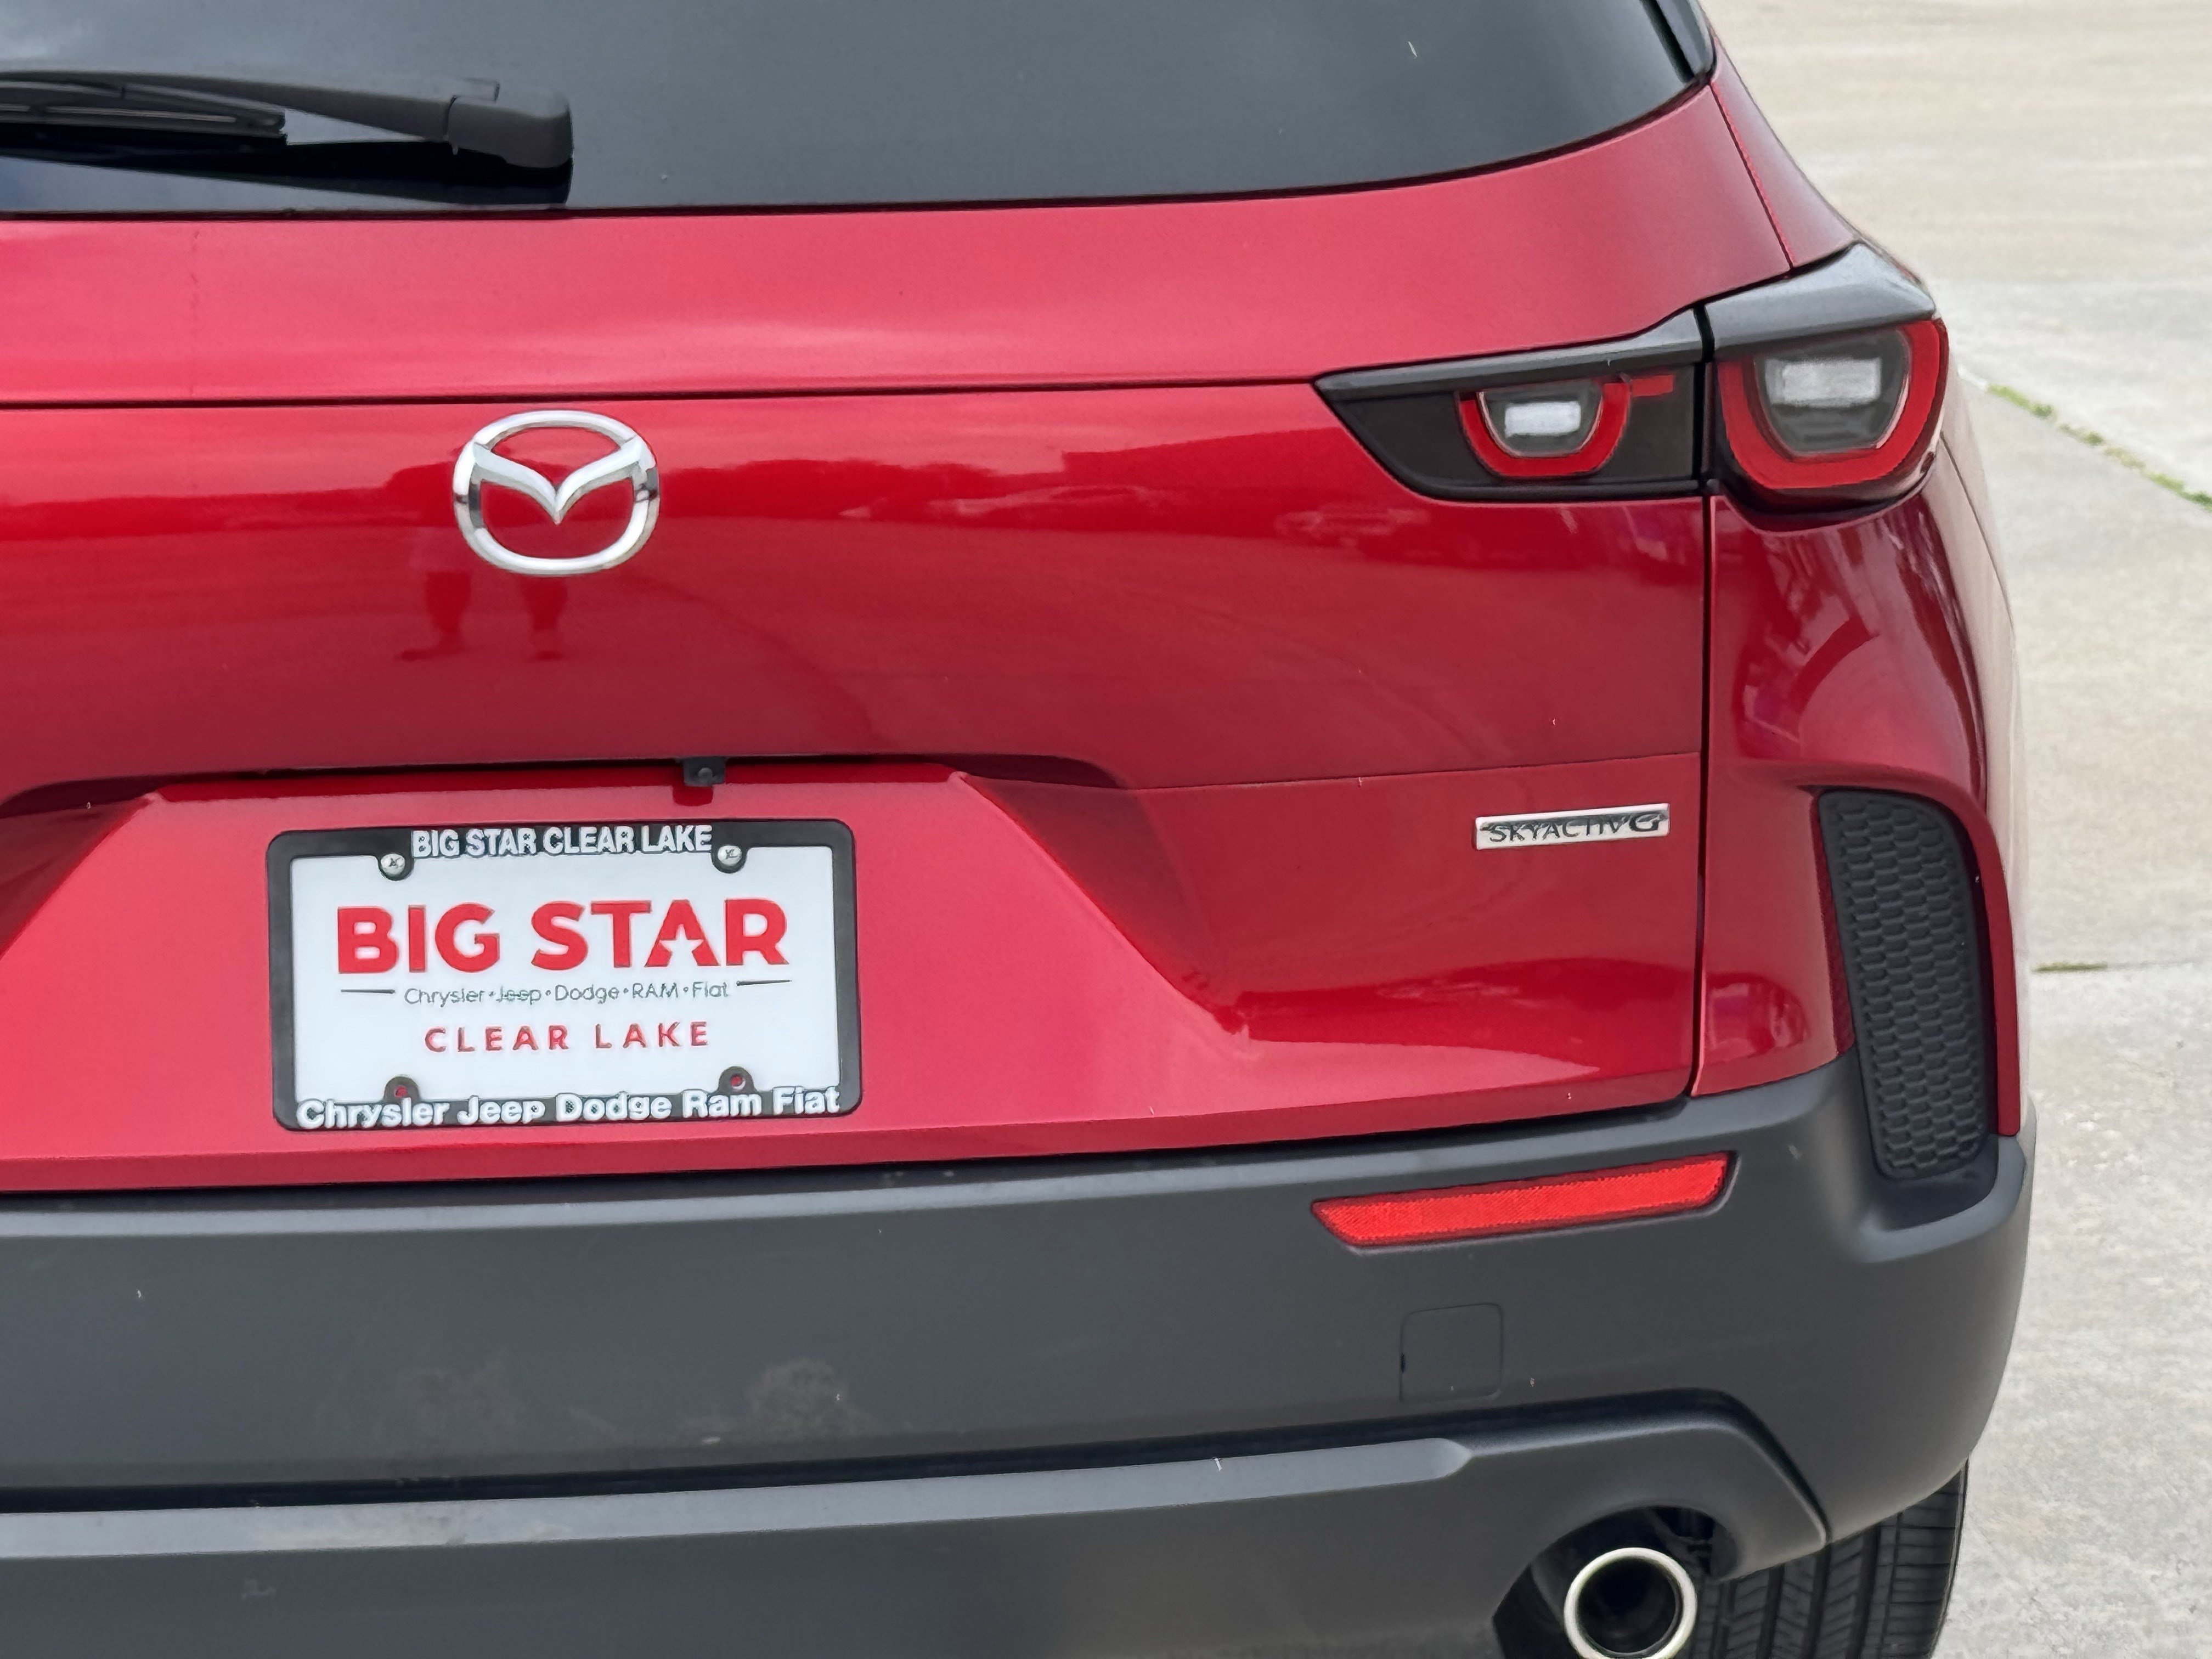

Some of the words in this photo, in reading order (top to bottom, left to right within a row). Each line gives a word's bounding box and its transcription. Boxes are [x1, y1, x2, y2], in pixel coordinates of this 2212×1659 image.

[413, 828, 460, 857] BIG
[466, 827, 537, 856] STAR
[543, 825, 635, 855] CLEAR
[641, 824, 712, 853] LAKE
[337, 903, 500, 973] BIG
[531, 898, 789, 970] STAR
[404, 988, 485, 1007] Chrysler
[555, 984, 619, 1003] Dodge
[632, 983, 679, 999] RAM
[424, 1025, 569, 1052] CLEAR
[595, 1022, 708, 1049] LAKE
[296, 1098, 450, 1129] Chrysler
[458, 1095, 545, 1125] Jeep
[556, 1092, 673, 1122] Dodge
[682, 1090, 761, 1119] Ram
[773, 1086, 841, 1115] Fiat
